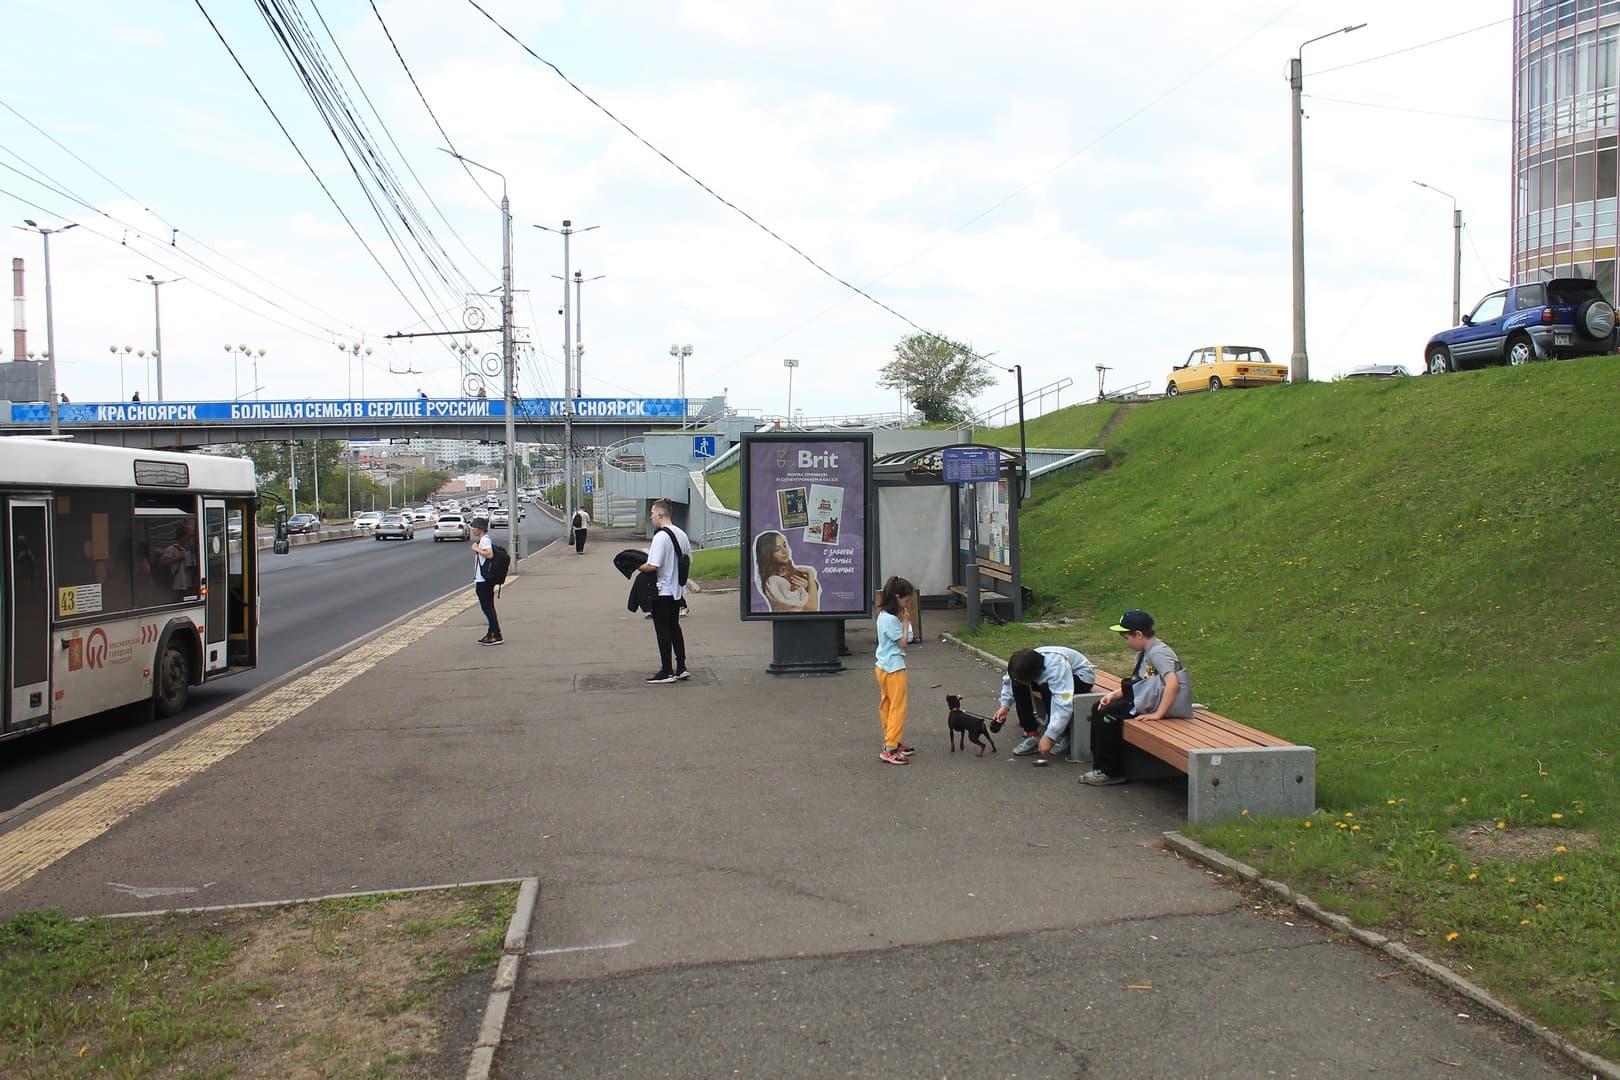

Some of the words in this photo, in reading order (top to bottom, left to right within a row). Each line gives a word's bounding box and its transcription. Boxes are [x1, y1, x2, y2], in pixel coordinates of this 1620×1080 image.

[98, 405, 196, 421] КРАСНОЯРСК
[231, 403, 303, 419] БОЛЬШАЯ
[306, 403, 351, 418] СЕМЬЯ
[354, 402, 363, 418] В
[367, 401, 422, 418] СЕРДЦЕ
[798, 449, 839, 469] Brit
[61, 590, 75, 611] 43
